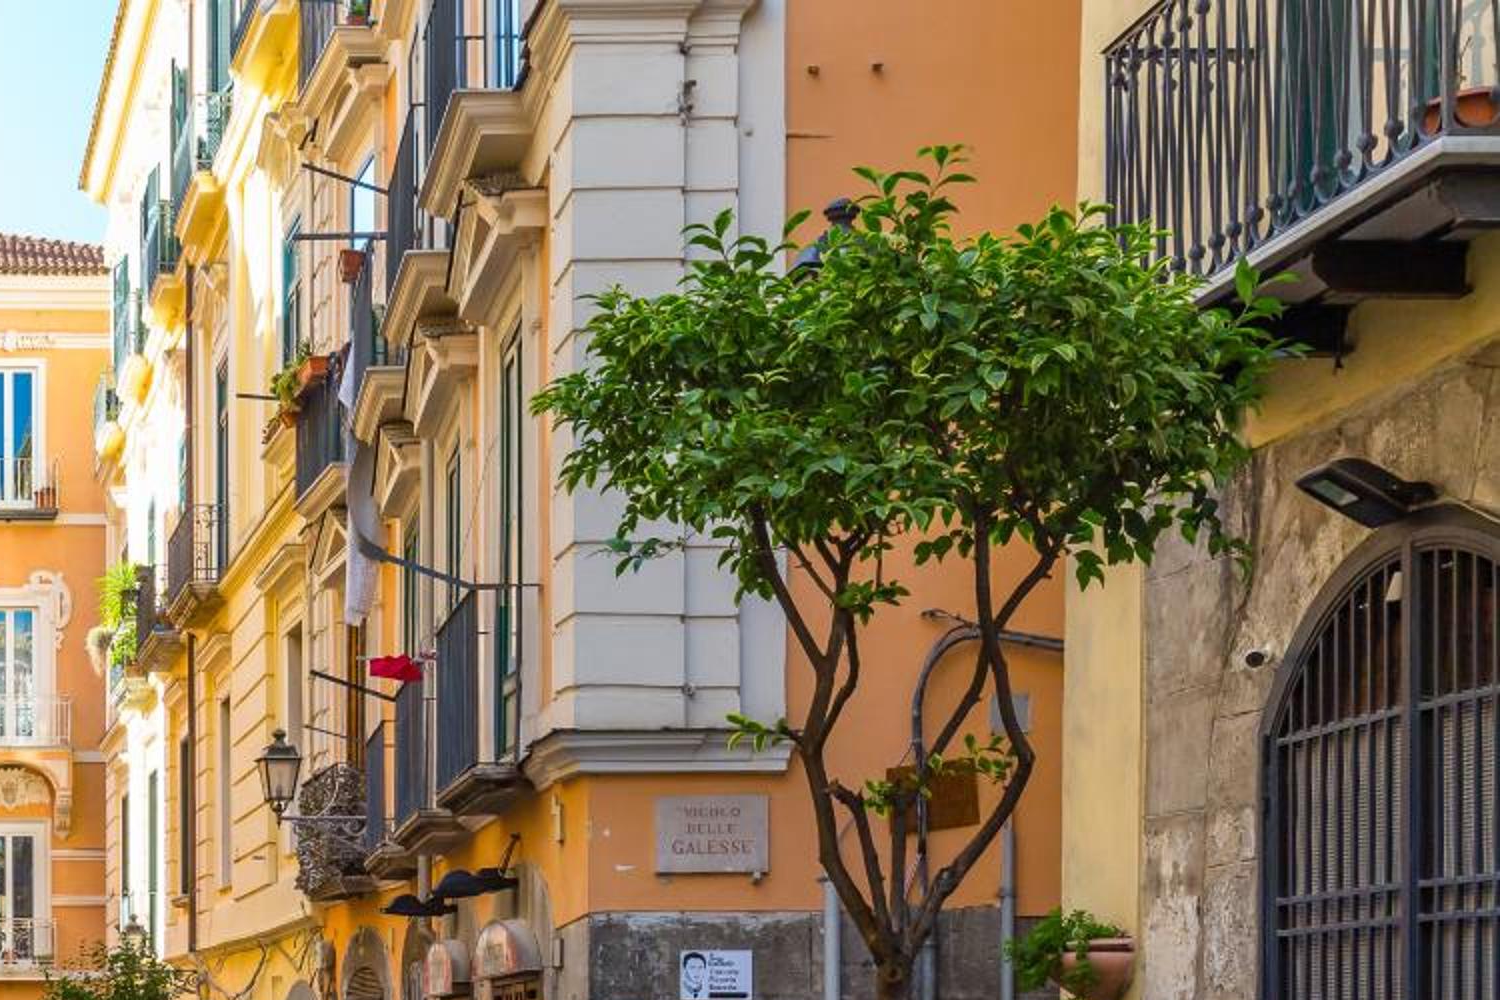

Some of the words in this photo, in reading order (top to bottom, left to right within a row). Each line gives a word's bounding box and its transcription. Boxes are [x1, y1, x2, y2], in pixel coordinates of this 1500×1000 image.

[683, 807, 741, 817] VICOLO
[686, 823, 741, 834] DELLE
[671, 840, 756, 855] GALESSE
